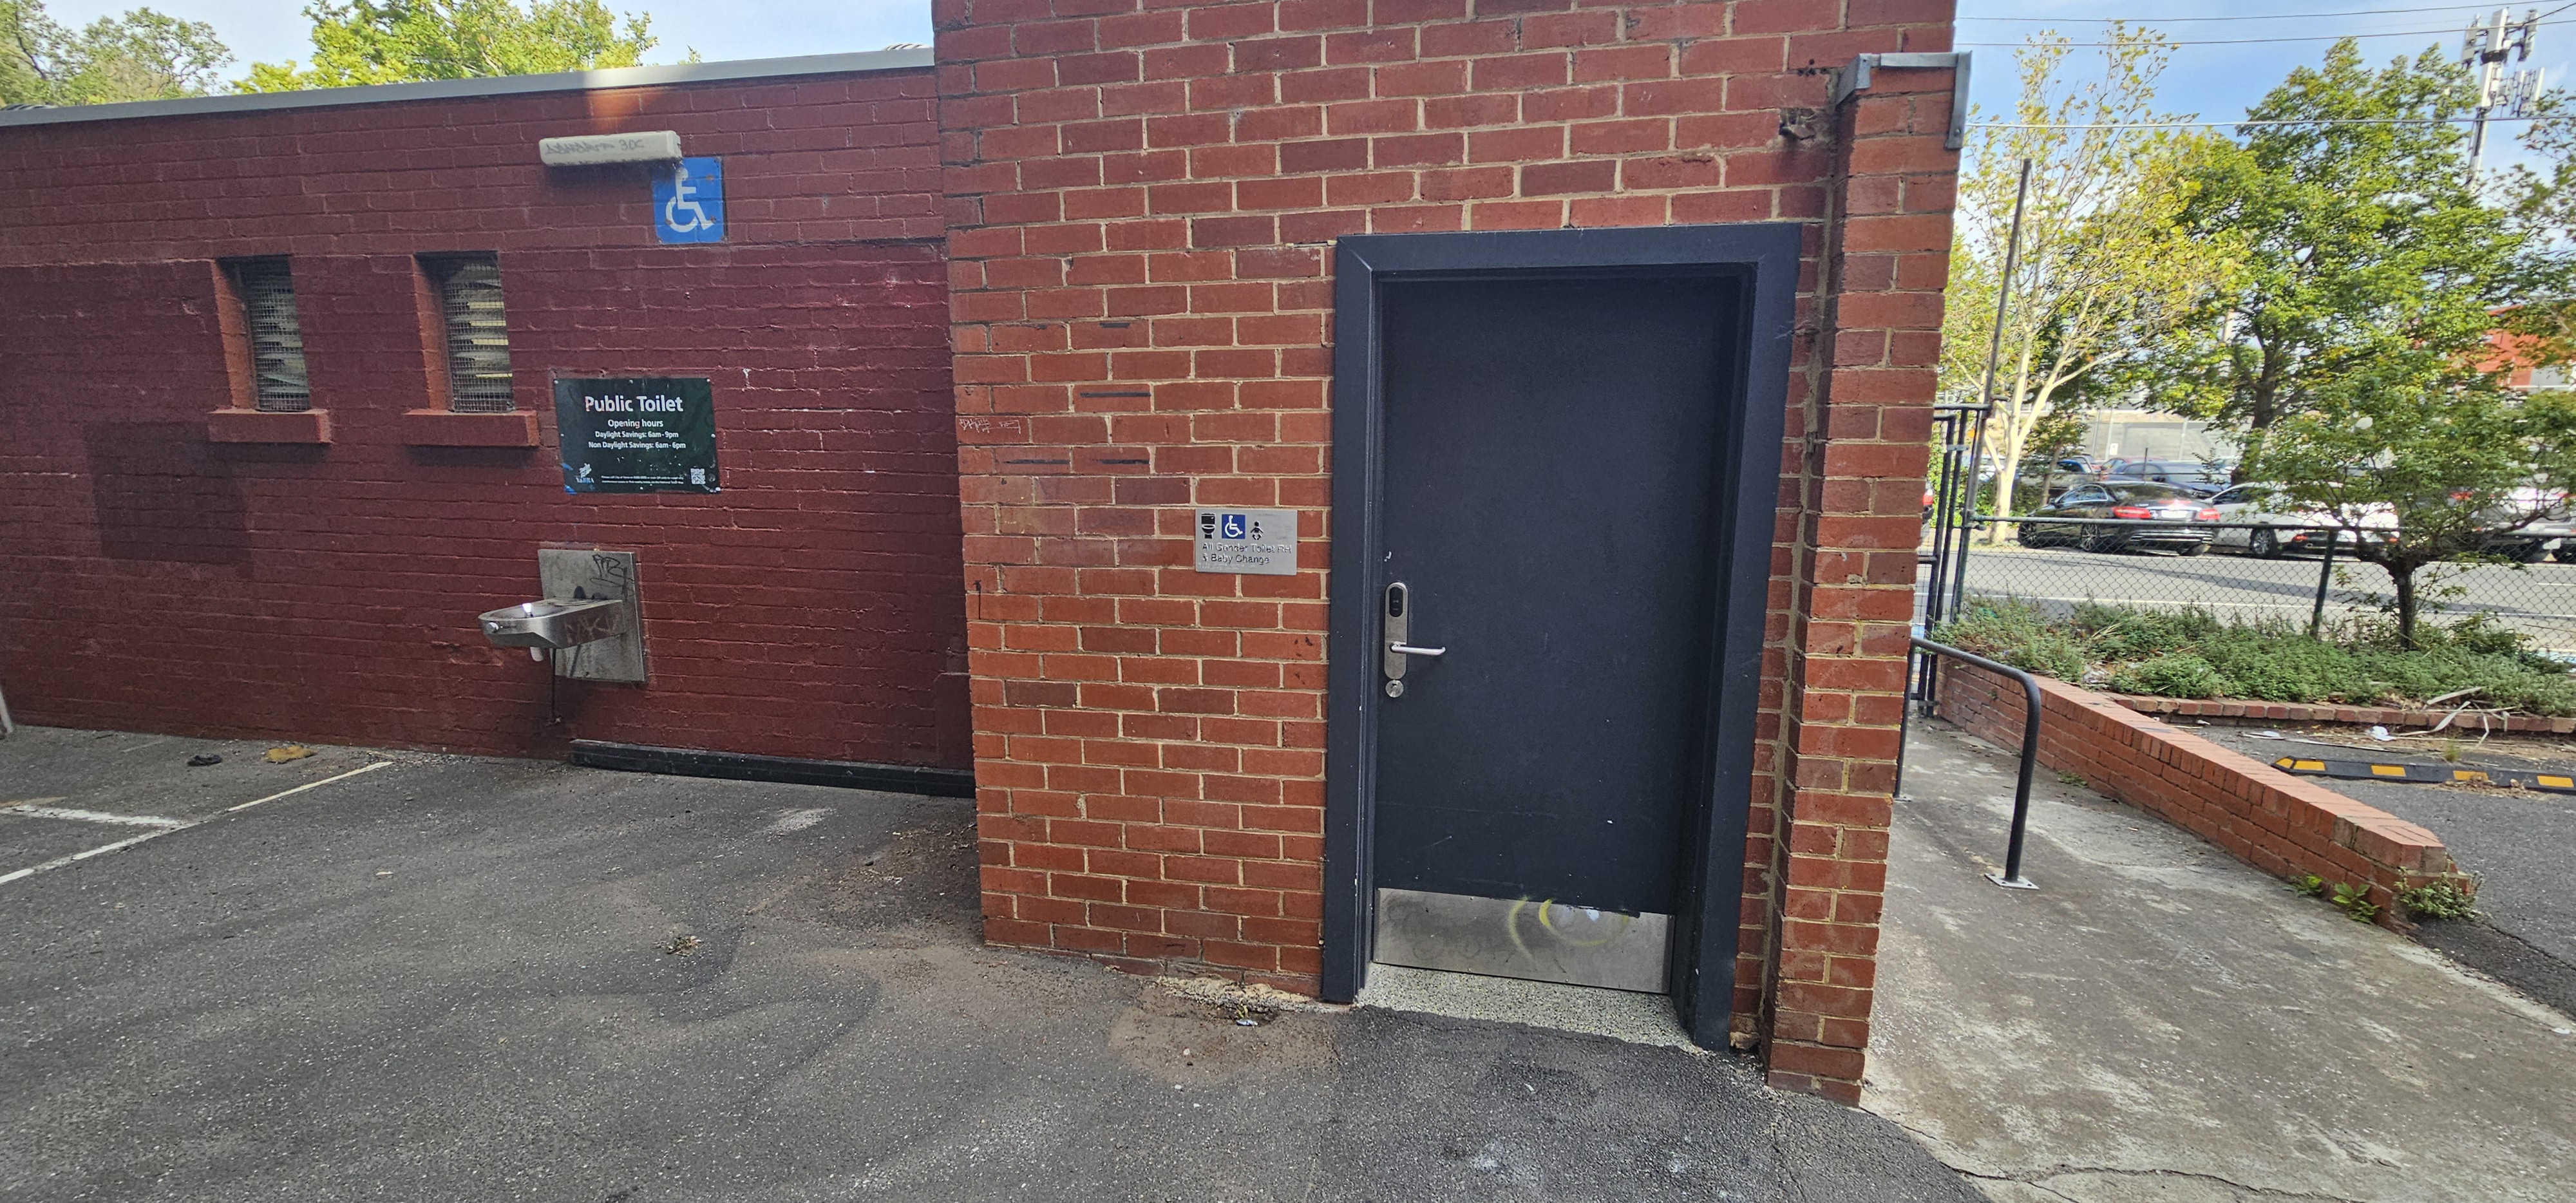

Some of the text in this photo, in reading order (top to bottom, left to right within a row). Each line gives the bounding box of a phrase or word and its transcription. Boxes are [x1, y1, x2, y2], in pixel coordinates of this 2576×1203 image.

[585, 395, 683, 412] Public Toilet
[607, 419, 640, 428] Opening
[595, 431, 621, 439] Daylight
[621, 431, 647, 439] Savings:
[1202, 542, 1213, 551] All
[1215, 543, 1248, 553] Gender
[1251, 544, 1275, 553] Toilet
[1211, 554, 1233, 564] Baby
[1235, 554, 1270, 565] Change
